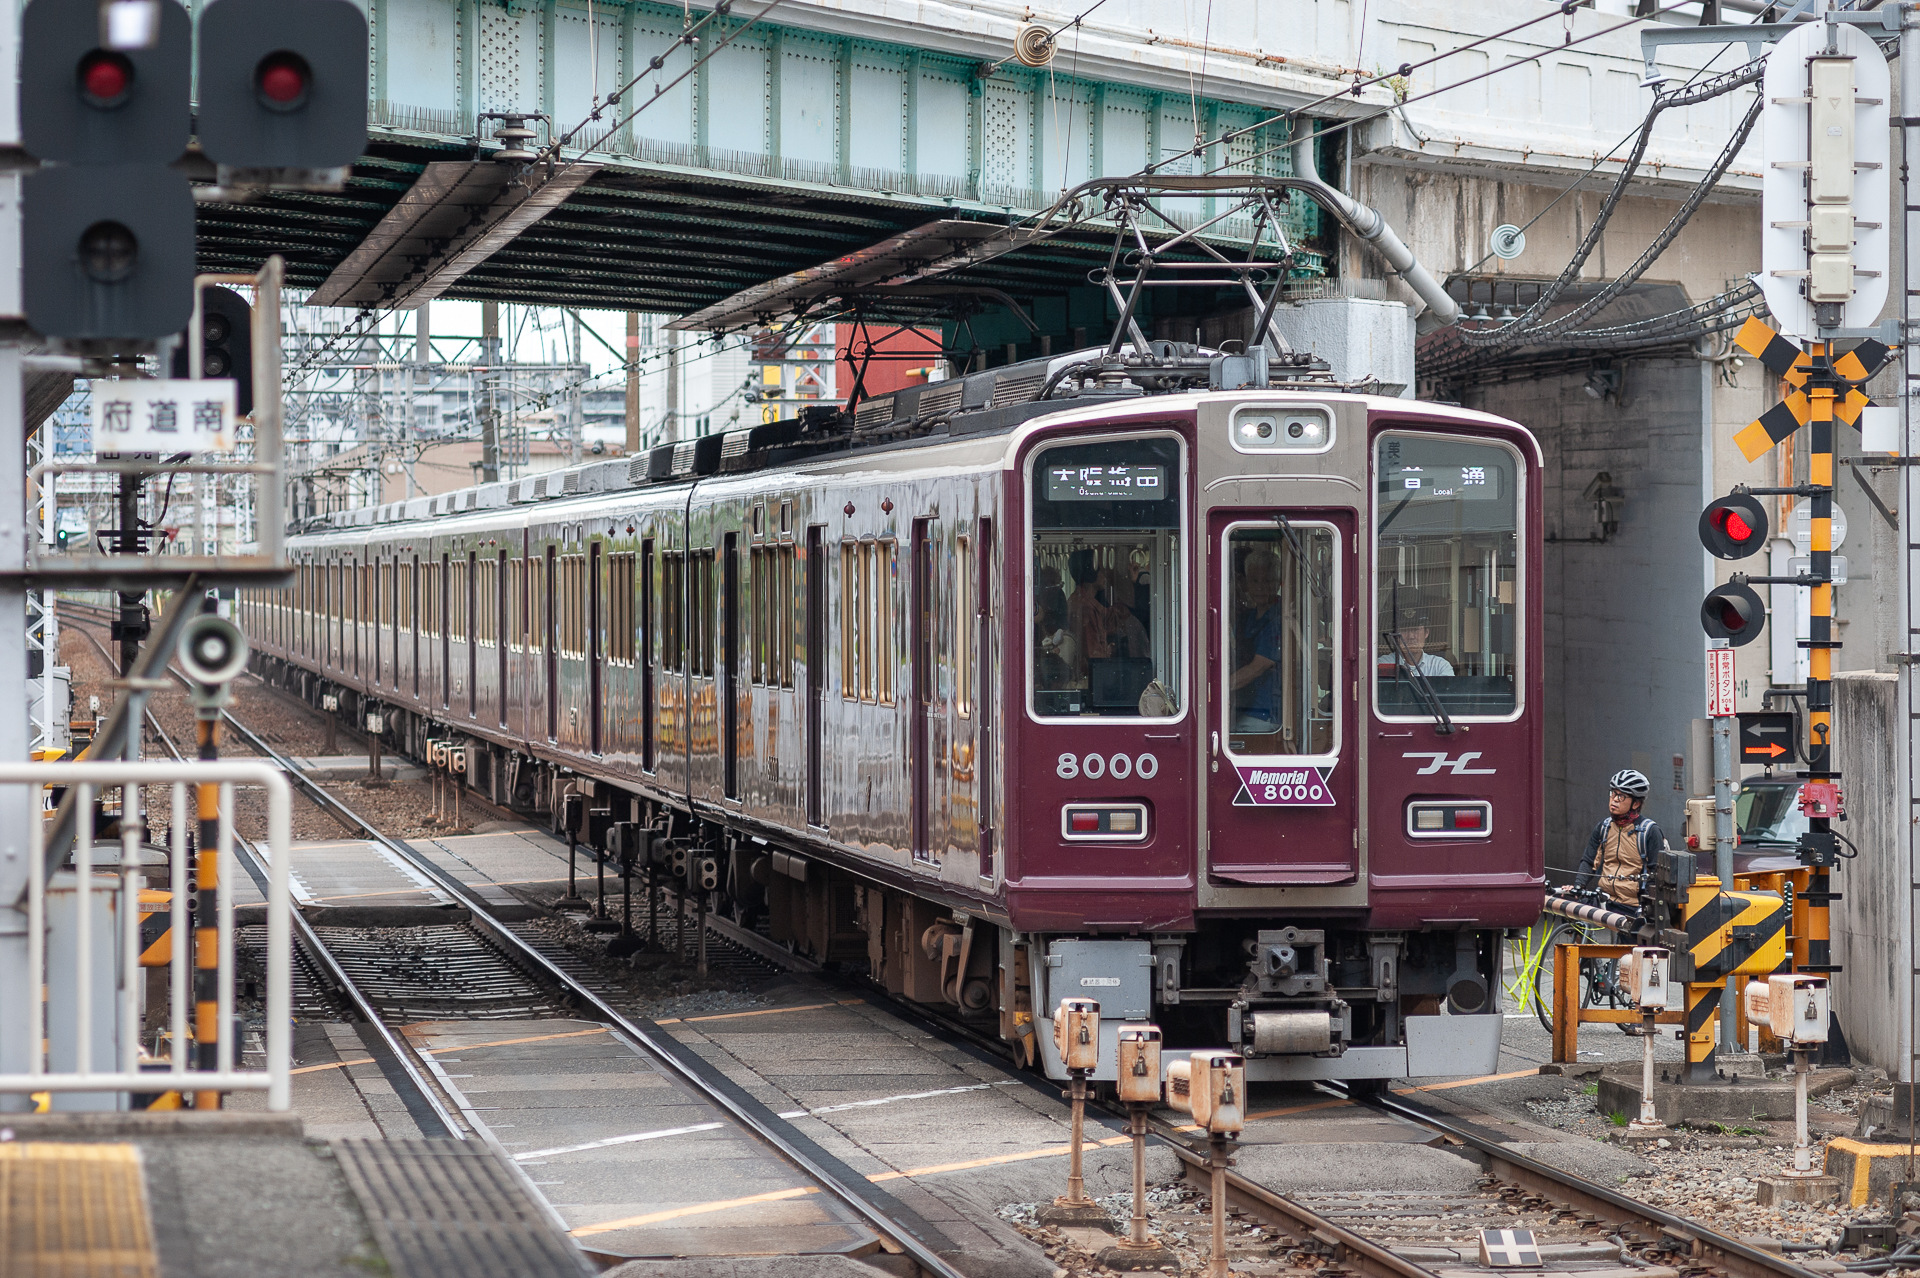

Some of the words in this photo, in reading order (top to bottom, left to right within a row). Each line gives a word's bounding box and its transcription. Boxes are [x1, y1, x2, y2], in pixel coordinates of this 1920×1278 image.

[101, 398, 224, 433] 府道南
[1722, 653, 1730, 697] 非常ボタン
[1056, 752, 1159, 780] 8000
[1249, 770, 1309, 785] Memorial
[1264, 785, 1323, 801] 8000
